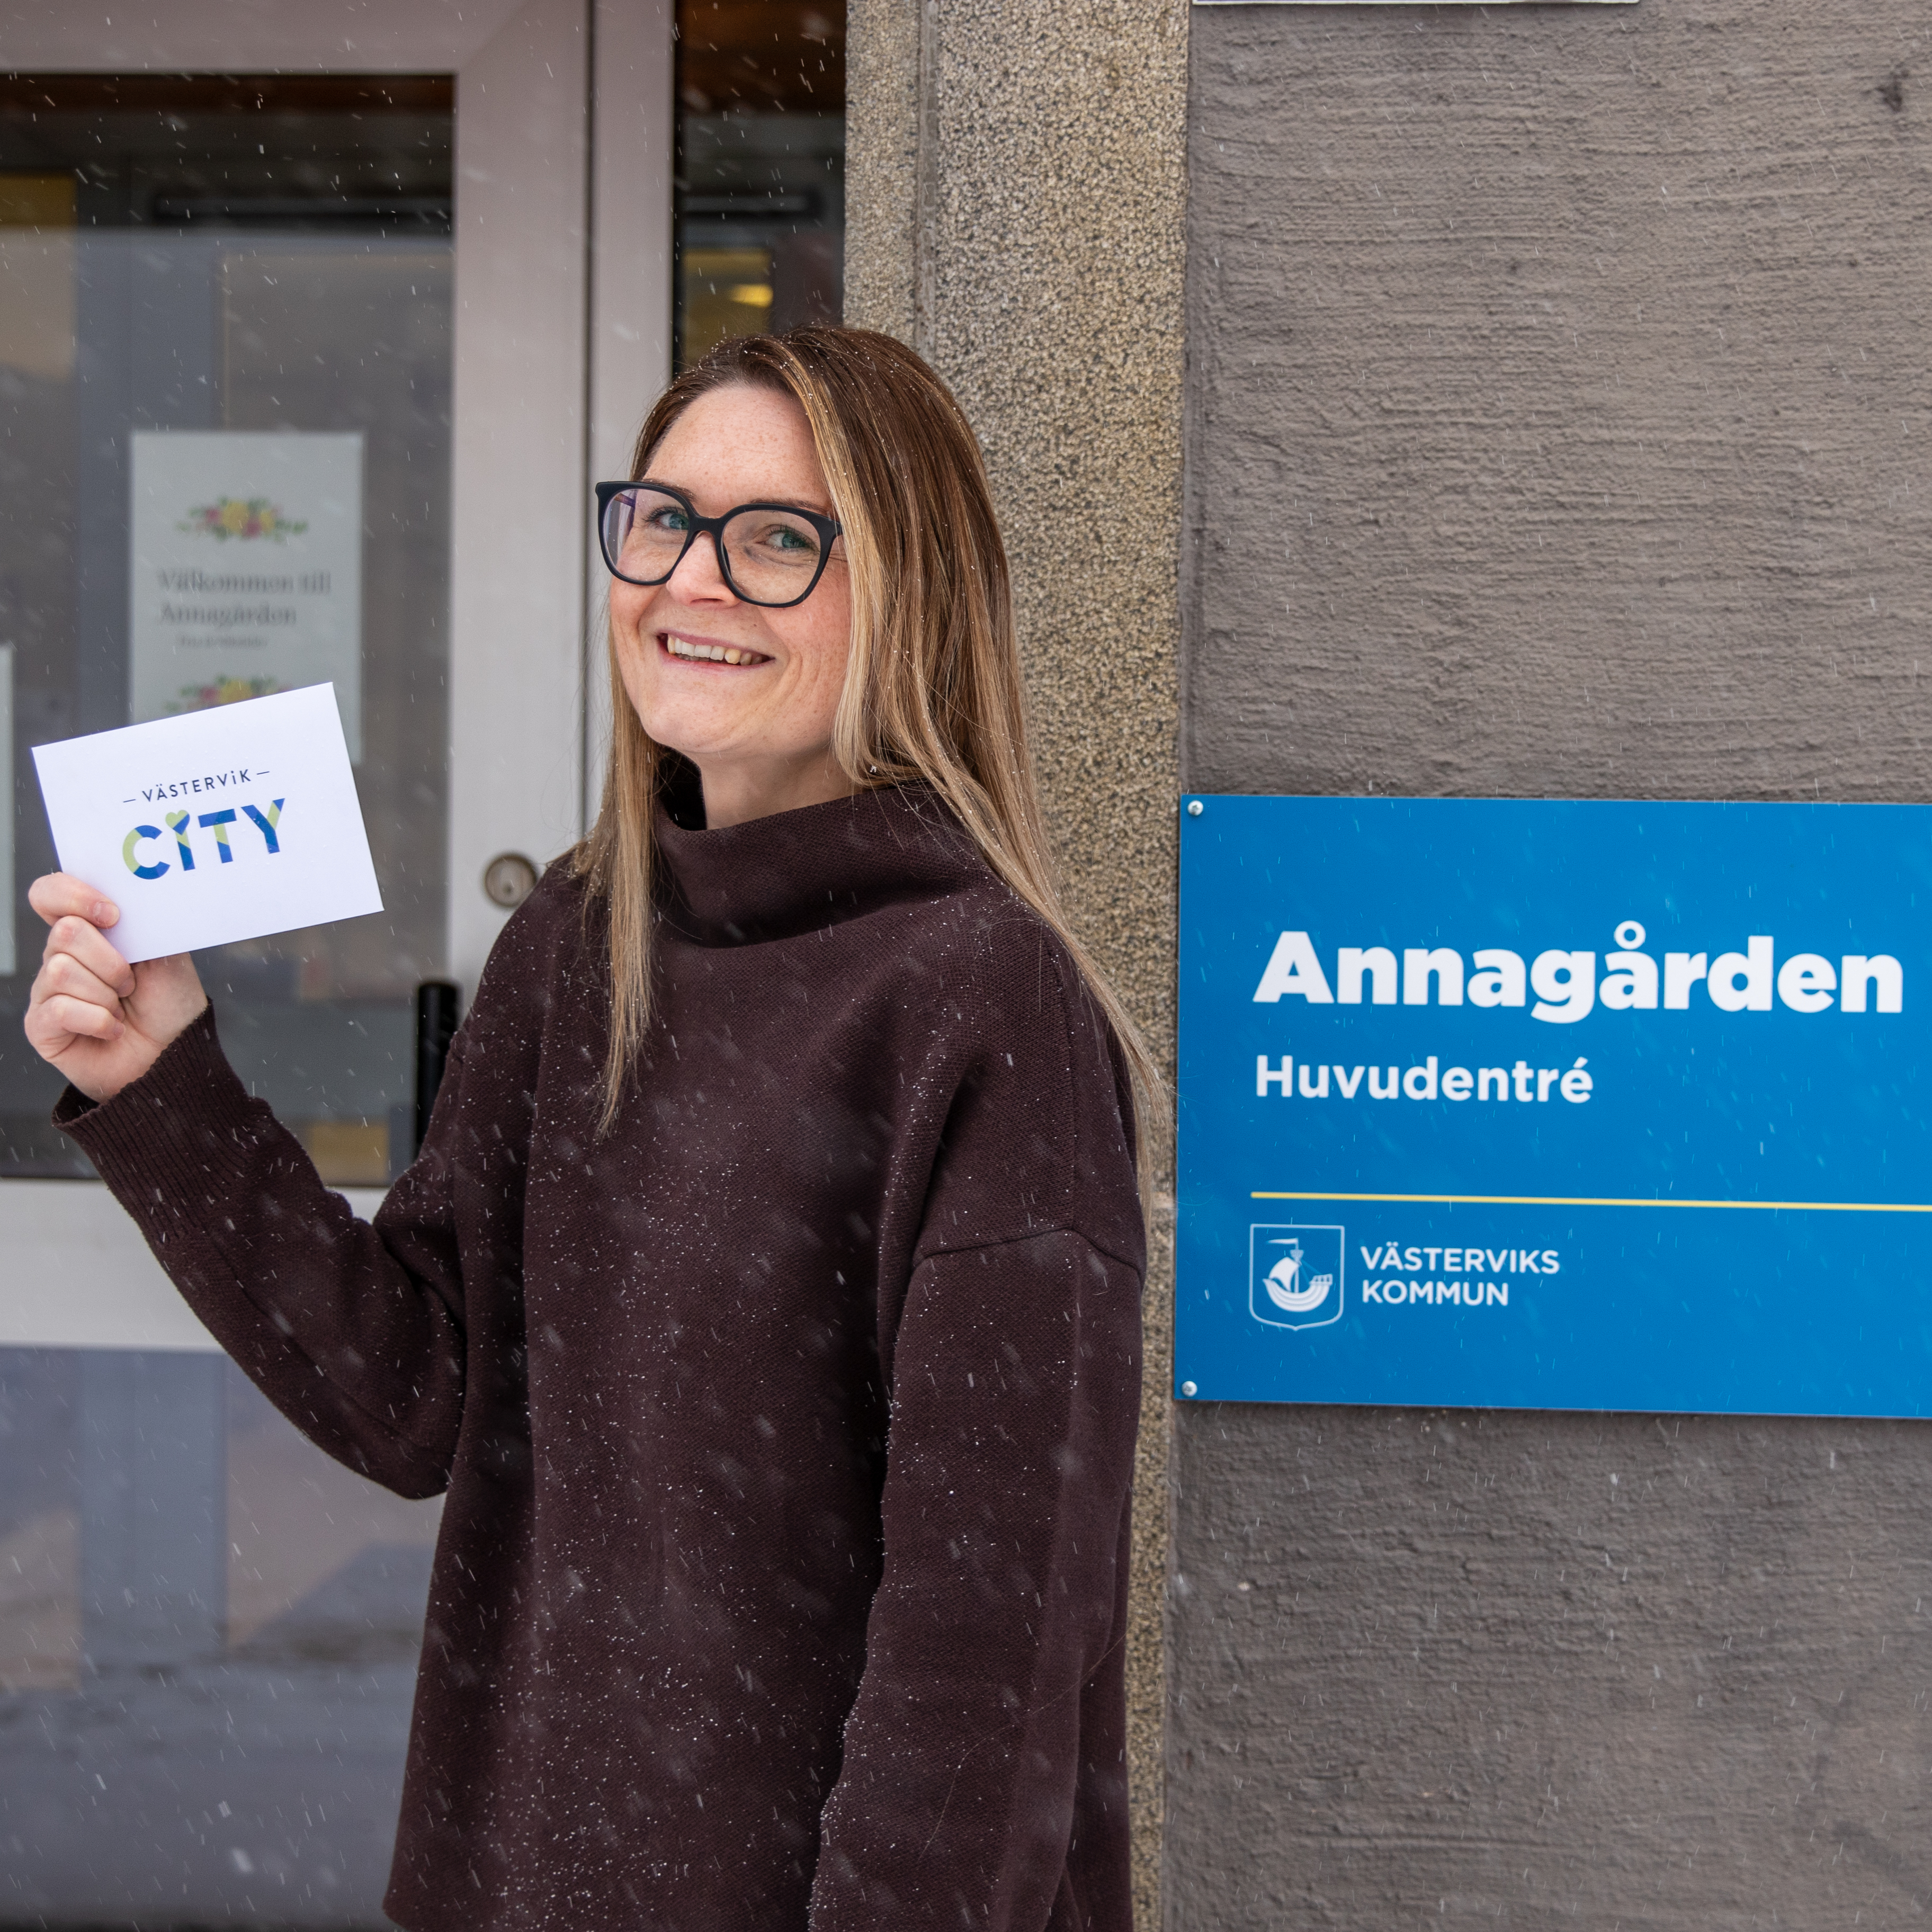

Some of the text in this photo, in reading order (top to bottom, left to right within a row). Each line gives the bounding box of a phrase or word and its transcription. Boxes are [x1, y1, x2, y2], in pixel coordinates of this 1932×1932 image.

[300, 569, 332, 595] till
[1253, 920, 1903, 1024] Annagården
[1256, 1054, 1594, 1103] Huvudentré
[1360, 1241, 1560, 1274] VÄSTERVIKS
[1362, 1279, 1509, 1306] KOMMUN
